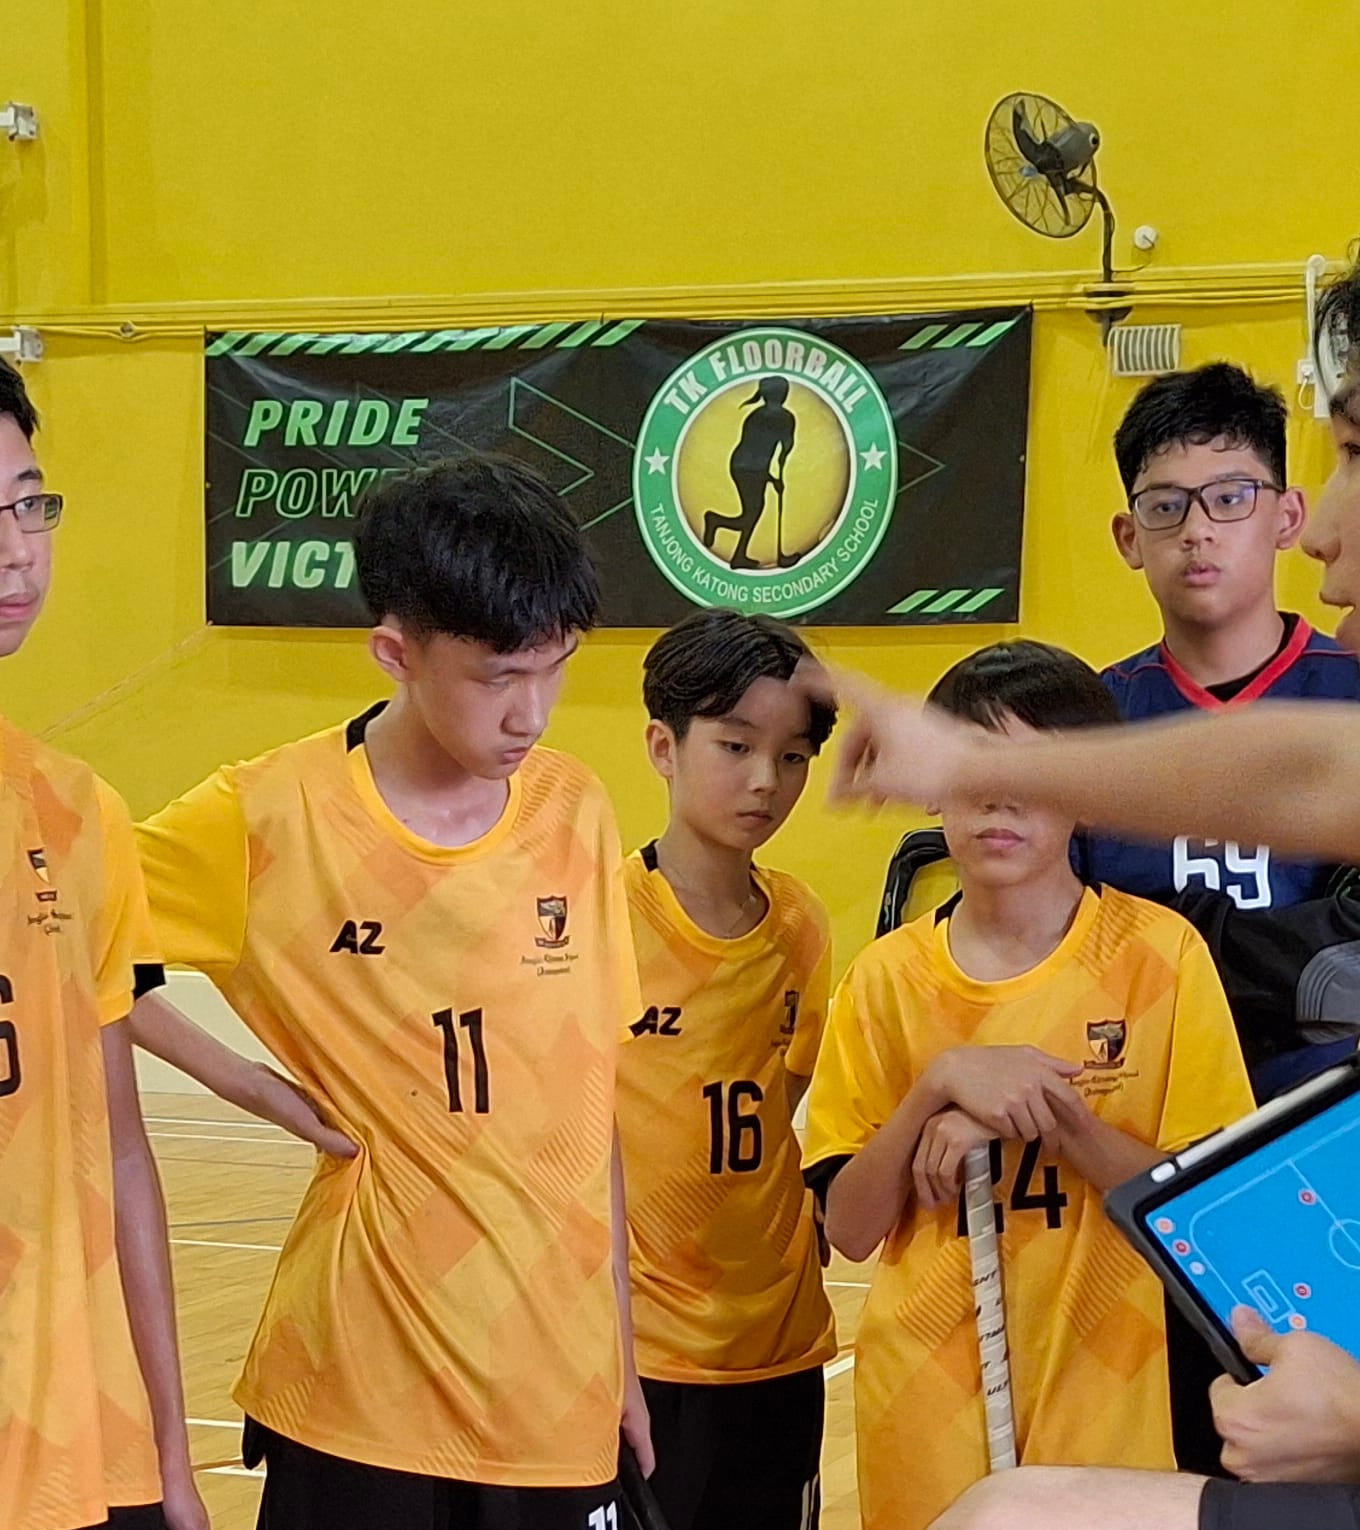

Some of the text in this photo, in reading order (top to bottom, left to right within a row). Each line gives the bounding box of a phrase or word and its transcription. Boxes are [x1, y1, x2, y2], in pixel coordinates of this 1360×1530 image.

[663, 338, 868, 415] TK FLOORBALL
[243, 398, 430, 446] PRIDE
[234, 466, 425, 518] POW
[649, 498, 879, 603] TANJONG KATONG SECONDARY SCHOOL
[329, 919, 387, 956] AZ
[639, 1005, 683, 1036] AZ
[431, 1006, 490, 1114] 11
[702, 1080, 764, 1175] 16
